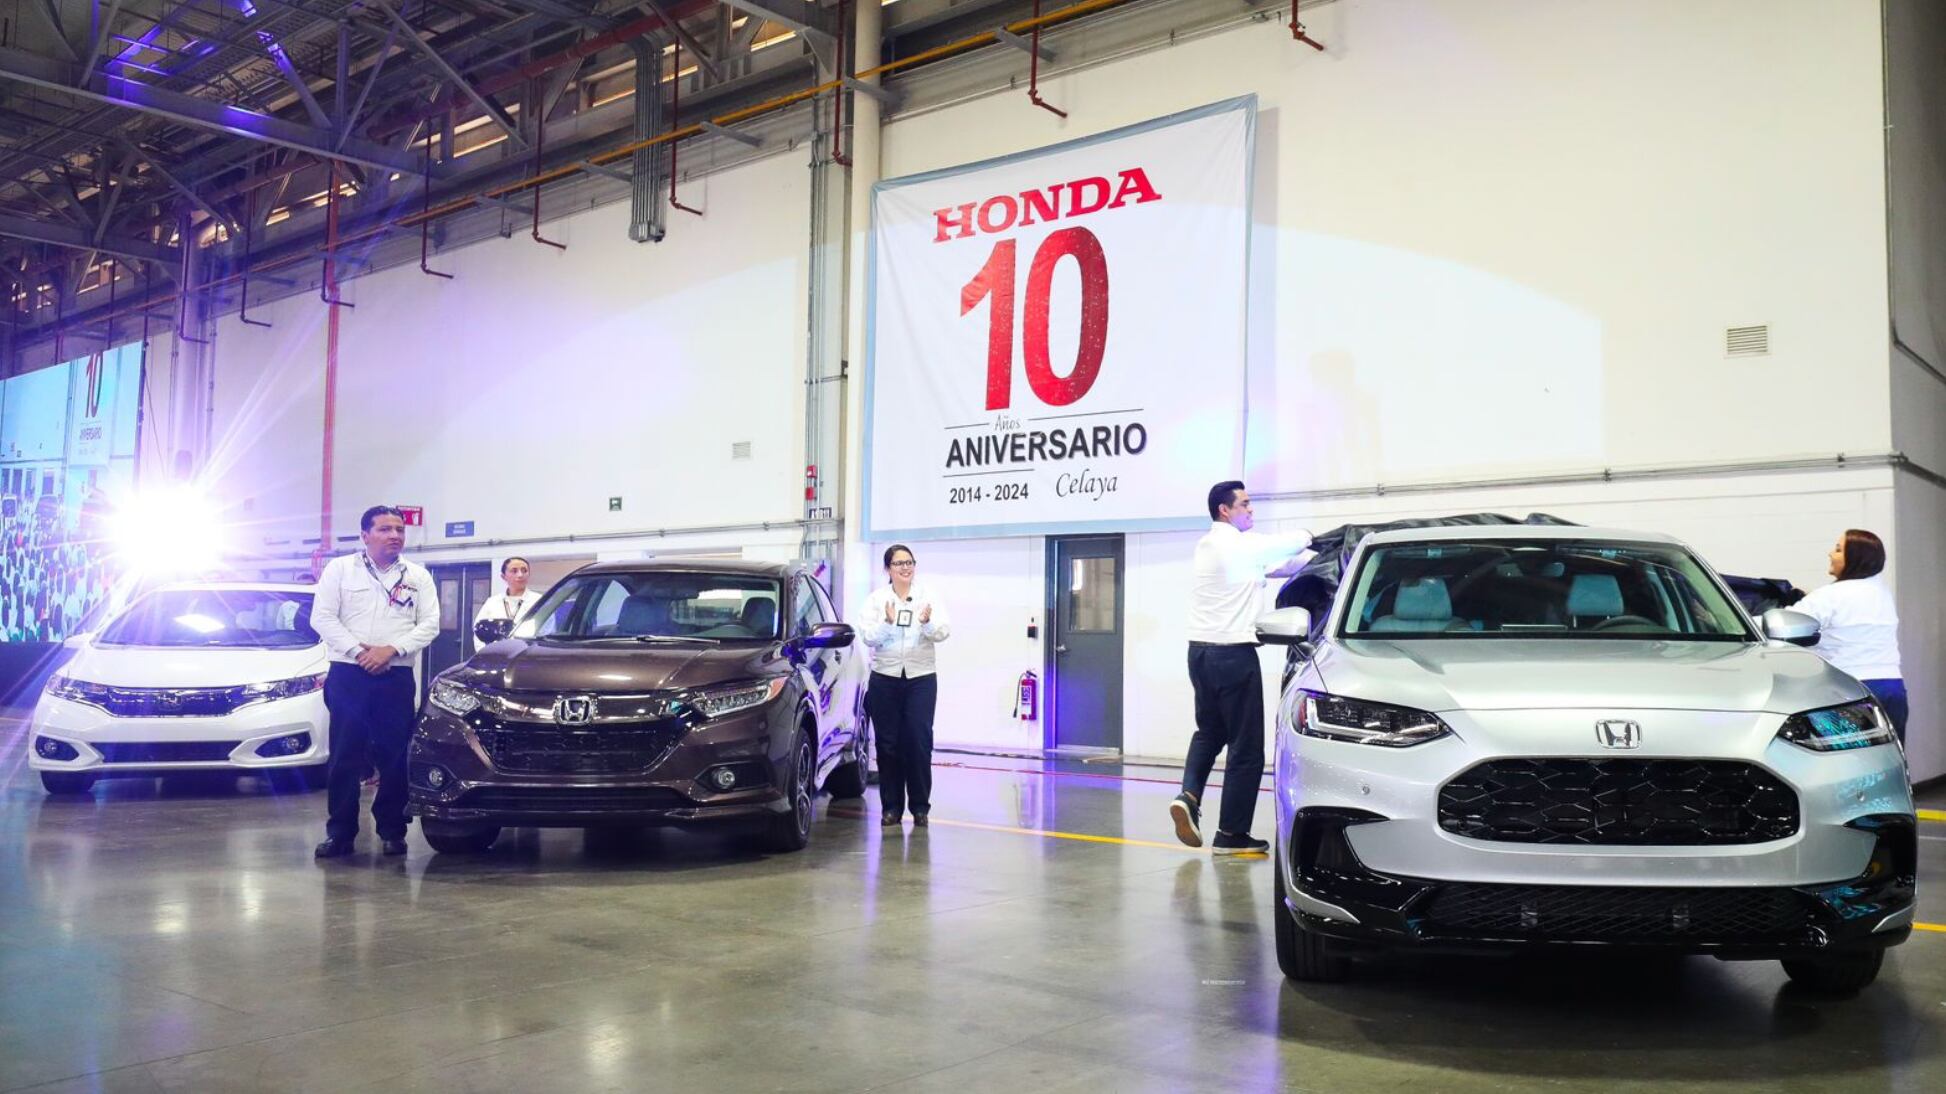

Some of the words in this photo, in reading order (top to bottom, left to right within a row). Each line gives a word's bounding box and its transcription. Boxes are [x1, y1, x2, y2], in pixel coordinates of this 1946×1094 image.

[933, 167, 1162, 242] HONDA
[960, 226, 1109, 411] 10
[946, 422, 1147, 468] ANIVERSARIO
[950, 486, 982, 504] 2014
[994, 483, 1029, 502] 2024
[1055, 468, 1118, 501] Celaya
